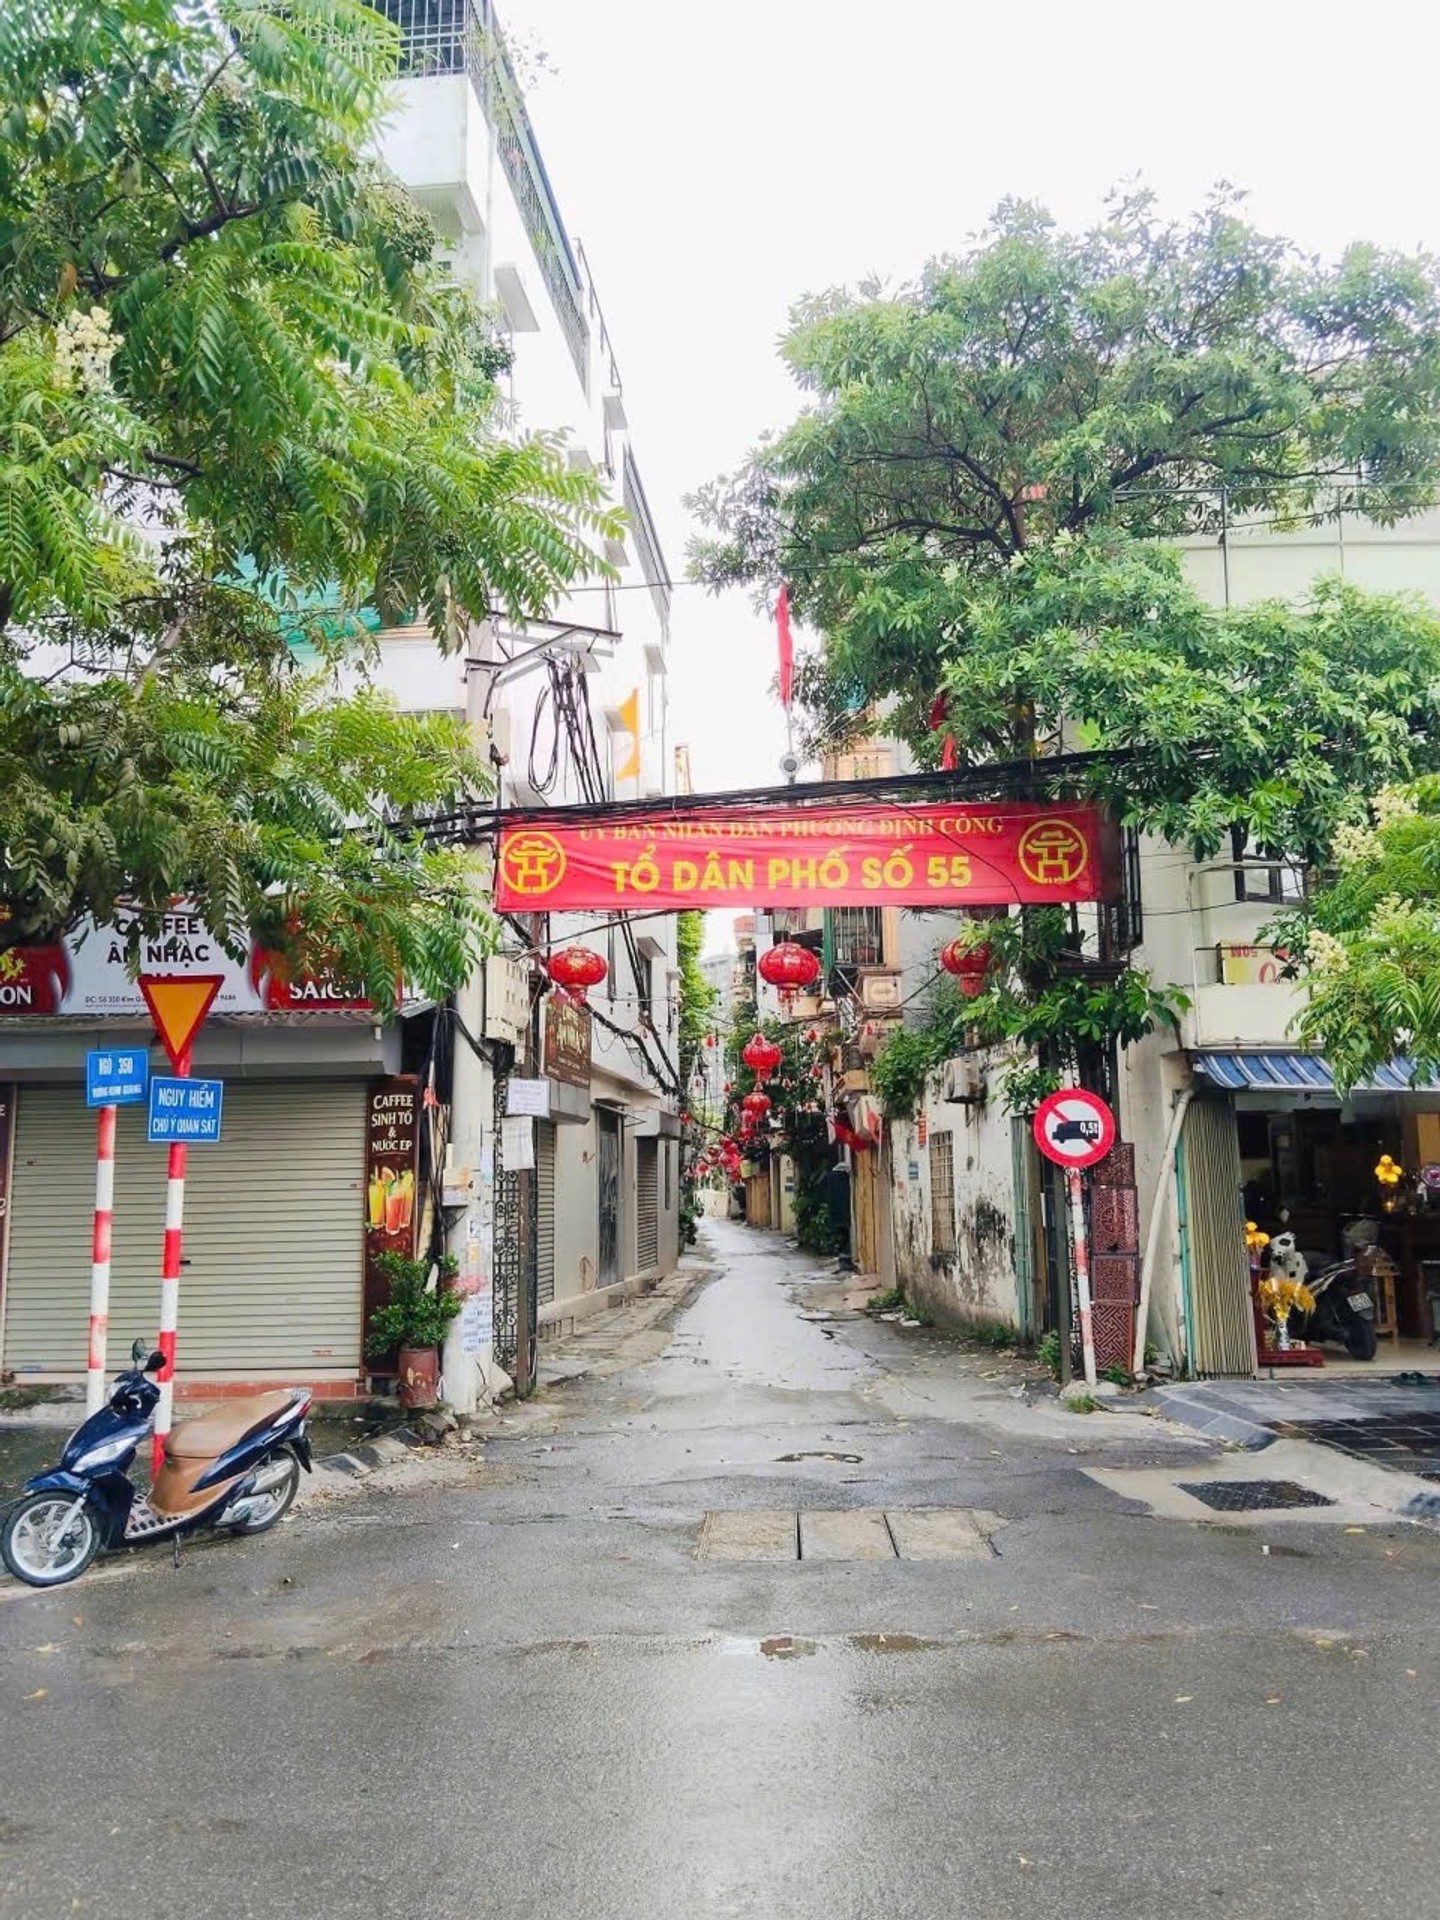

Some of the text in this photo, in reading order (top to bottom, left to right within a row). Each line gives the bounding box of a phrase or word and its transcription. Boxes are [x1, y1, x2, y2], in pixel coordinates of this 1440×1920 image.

[939, 812, 1003, 834] CÔNG
[610, 843, 973, 893] TỔ DÂN PHỐ SỐ 55
[147, 944, 210, 968] NHẠC
[158, 1083, 214, 1108] NGUY HIỂM
[373, 1094, 414, 1109] CAFFEE
[152, 1113, 216, 1134] CHÚ Ý QUAN SÁT
[371, 1108, 413, 1127] SINH TỐ
